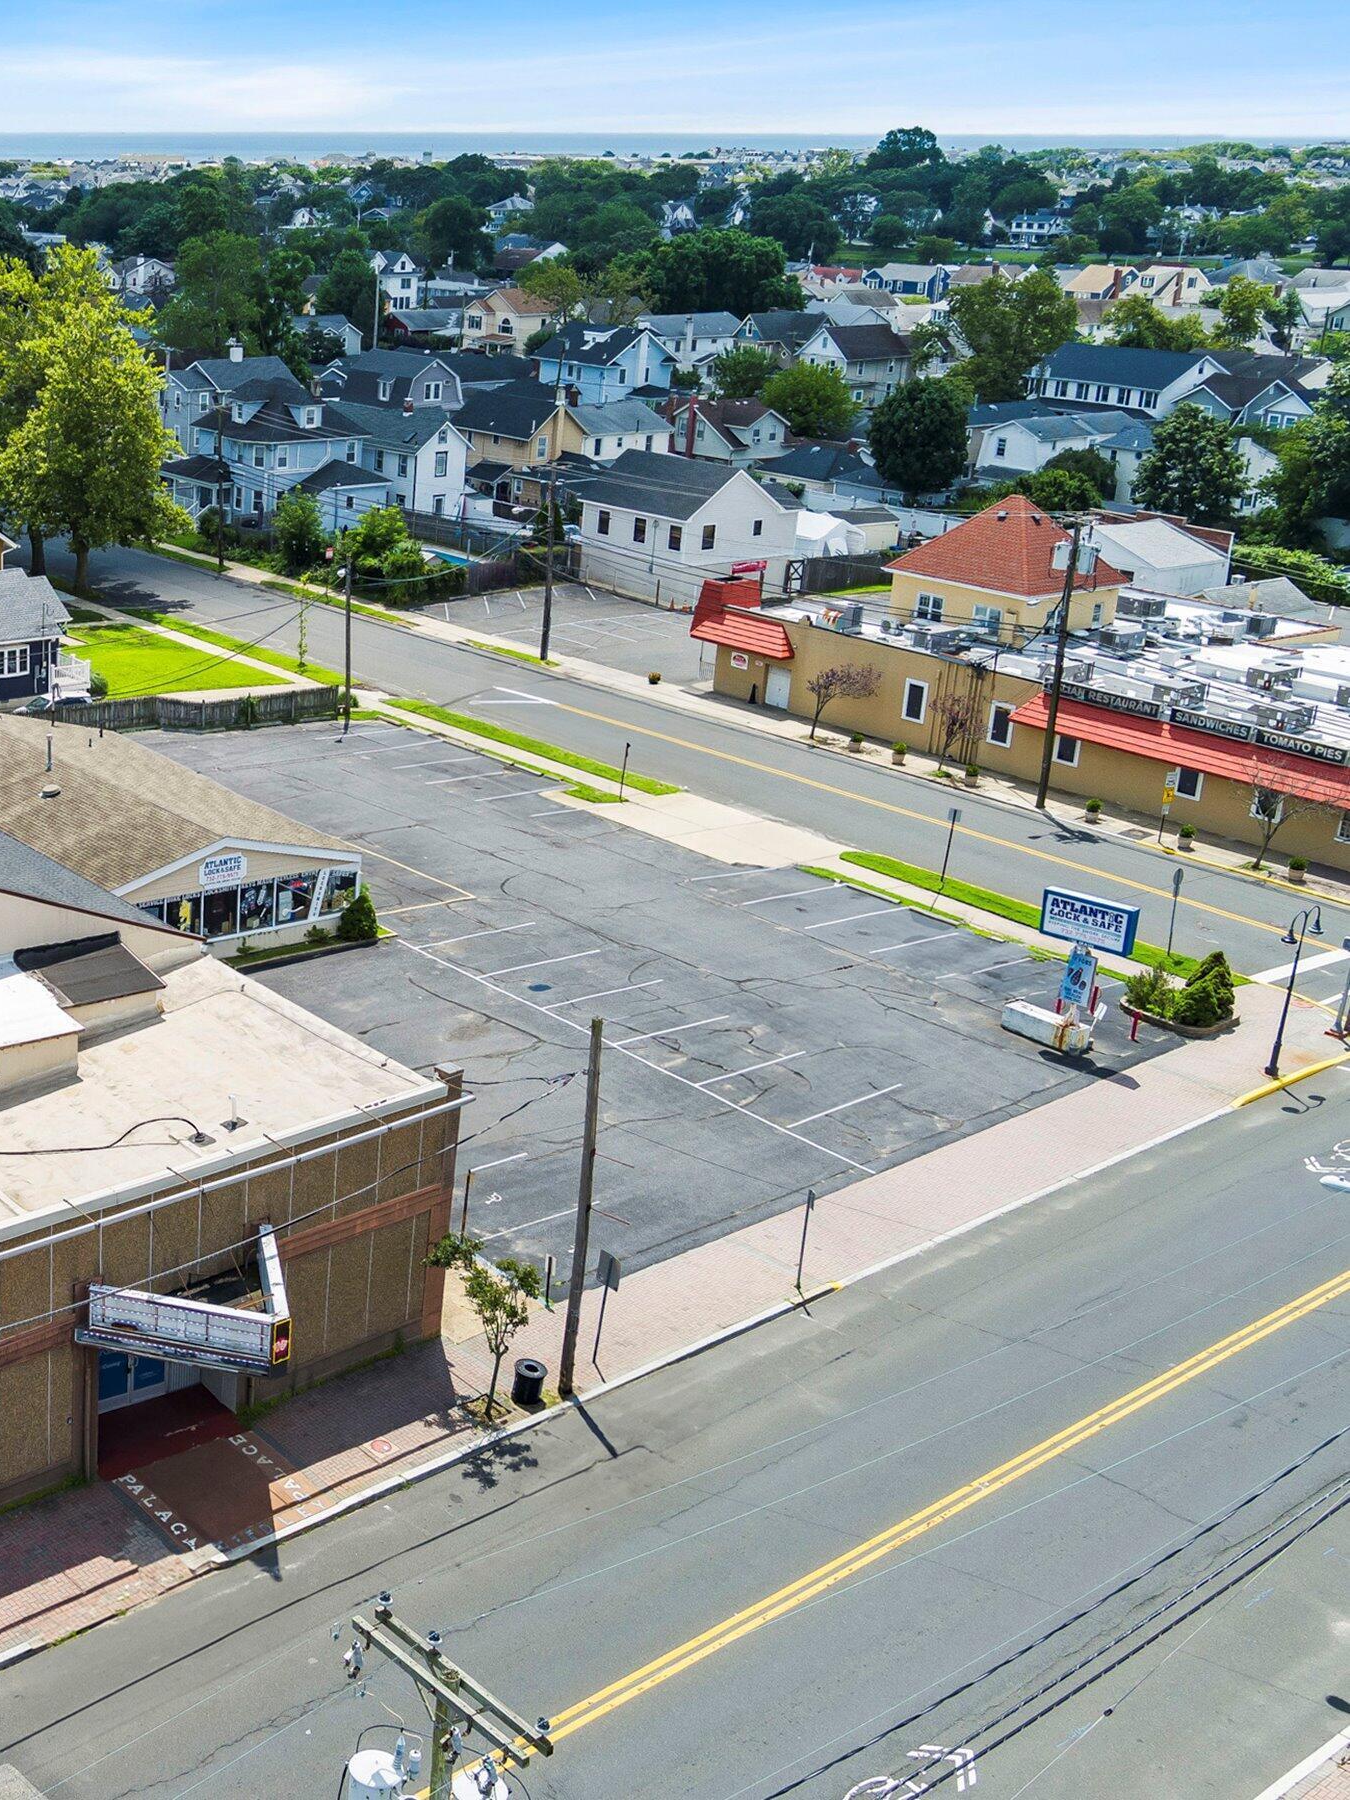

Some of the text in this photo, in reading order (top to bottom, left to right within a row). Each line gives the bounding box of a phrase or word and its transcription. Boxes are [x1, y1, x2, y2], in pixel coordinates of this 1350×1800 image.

[1089, 692, 1158, 715] RESTAURANT
[1175, 712, 1248, 737] SANDWICHES
[1263, 732, 1343, 761] TOMATO PIES
[204, 856, 242, 869] ATLANTIC
[1049, 908, 1081, 922] LOCK
[1091, 919, 1122, 933] SAFE
[1051, 897, 1124, 925] ATLANTIC
[228, 1434, 310, 1501] PALACE
